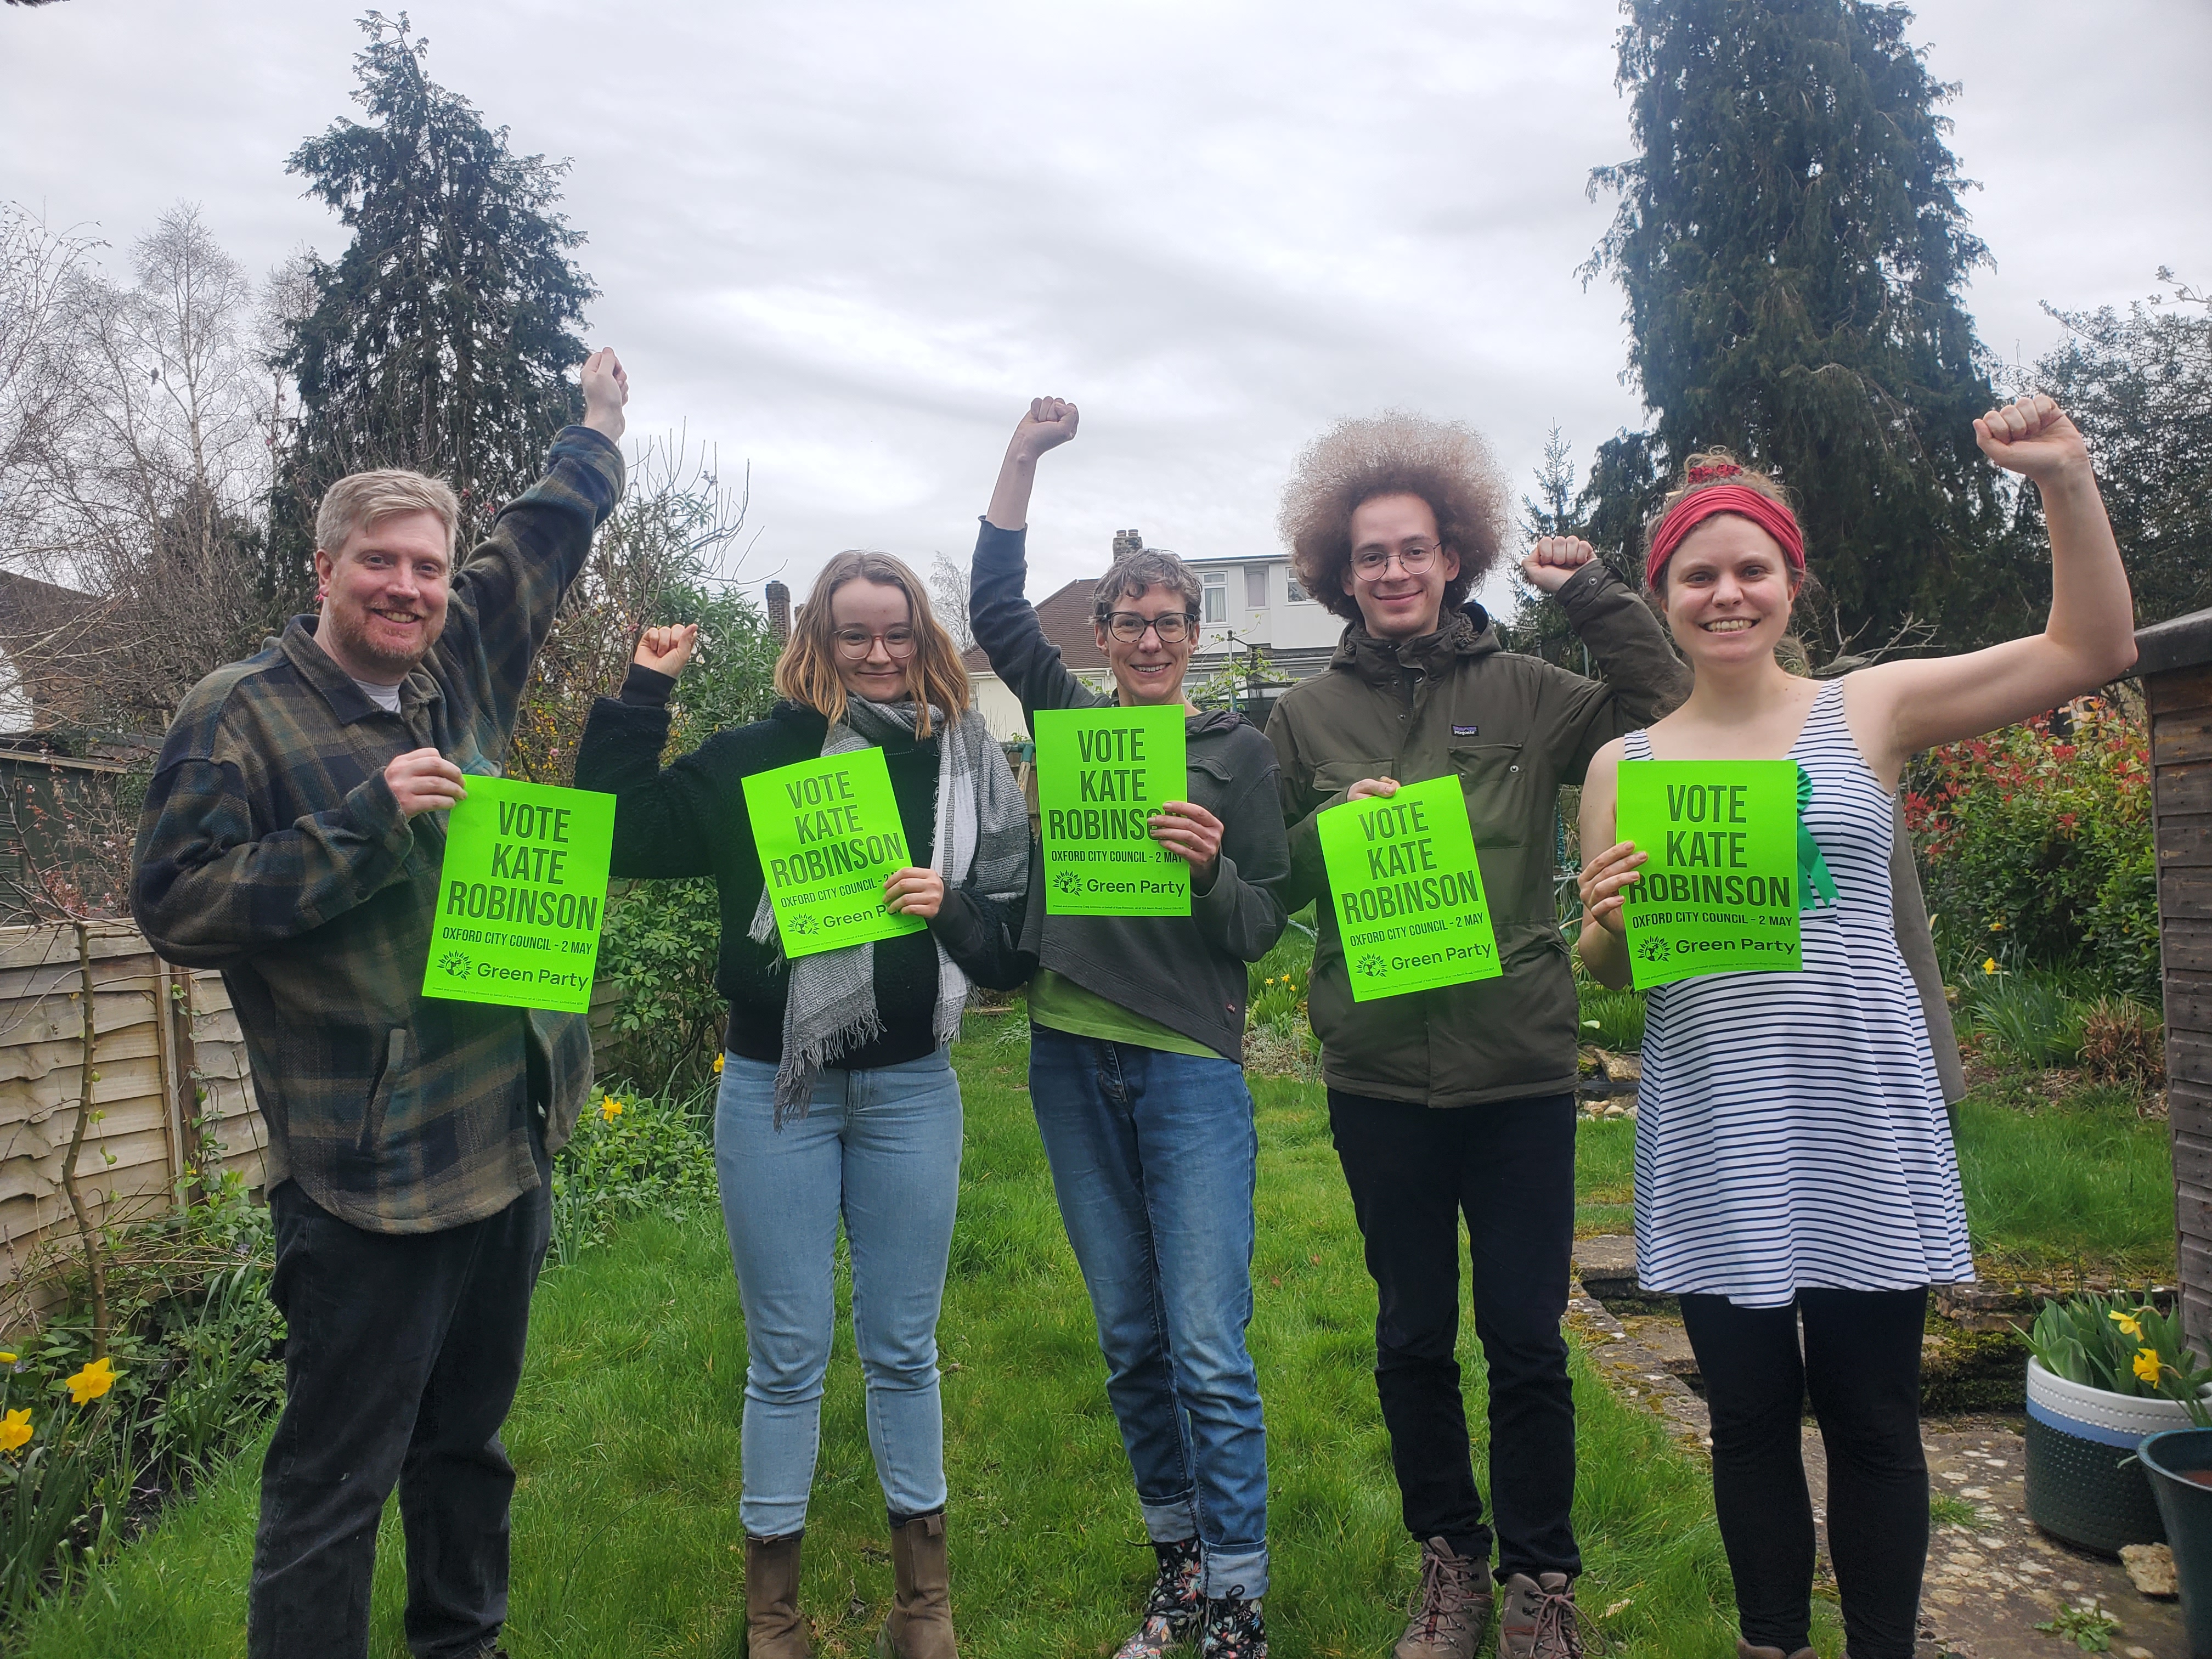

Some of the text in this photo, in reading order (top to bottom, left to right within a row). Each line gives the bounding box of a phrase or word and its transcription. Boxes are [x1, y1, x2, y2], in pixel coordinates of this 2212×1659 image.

[1077, 728, 1146, 763] VOTE
[785, 770, 855, 809] VOTE
[1080, 769, 1147, 802] KATE
[499, 800, 571, 843] VOTE
[1358, 800, 1429, 842] VOTE
[1667, 785, 1747, 823] VOTE
[794, 804, 864, 845] KATE
[1048, 808, 1181, 840] ROBINSO
[491, 843, 567, 885] KATE
[770, 832, 904, 888] ROBINSON
[1051, 850, 1086, 861] OXFORD
[1088, 850, 1108, 862] CITY
[1110, 851, 1147, 862] COUNCIL
[1155, 851, 1161, 863] 2
[1367, 838, 1437, 881] KATE
[1667, 831, 1747, 868] KATE
[447, 880, 598, 931] ROBINSON
[780, 892, 816, 908] OXFORD
[817, 887, 837, 901] CITY
[839, 878, 878, 896] COUNCIL
[1087, 878, 1185, 898] Green Party
[1341, 870, 1479, 925] ROBINSON
[1629, 873, 1790, 907] ROBINSON
[823, 910, 873, 928] Green
[1350, 930, 1385, 947] OXFORD
[1387, 926, 1406, 940] CITY
[1409, 919, 1448, 936] COUNCIL
[1455, 916, 1463, 928] 2
[1464, 912, 1483, 926] MAY
[1632, 912, 1673, 929] OXFORD
[1675, 912, 1699, 922] CITY
[1702, 912, 1748, 924] COUNCIL
[1758, 915, 1765, 925] 2
[1769, 916, 1792, 926] MAY
[442, 927, 482, 943] OXFORD
[484, 932, 508, 945] CITY
[509, 934, 551, 951] COUNCIL
[561, 940, 568, 952] 2
[571, 941, 592, 955] MAY
[1391, 943, 1491, 970] Green Party
[1675, 938, 1796, 955] Green Party
[477, 962, 589, 992] Green Party
